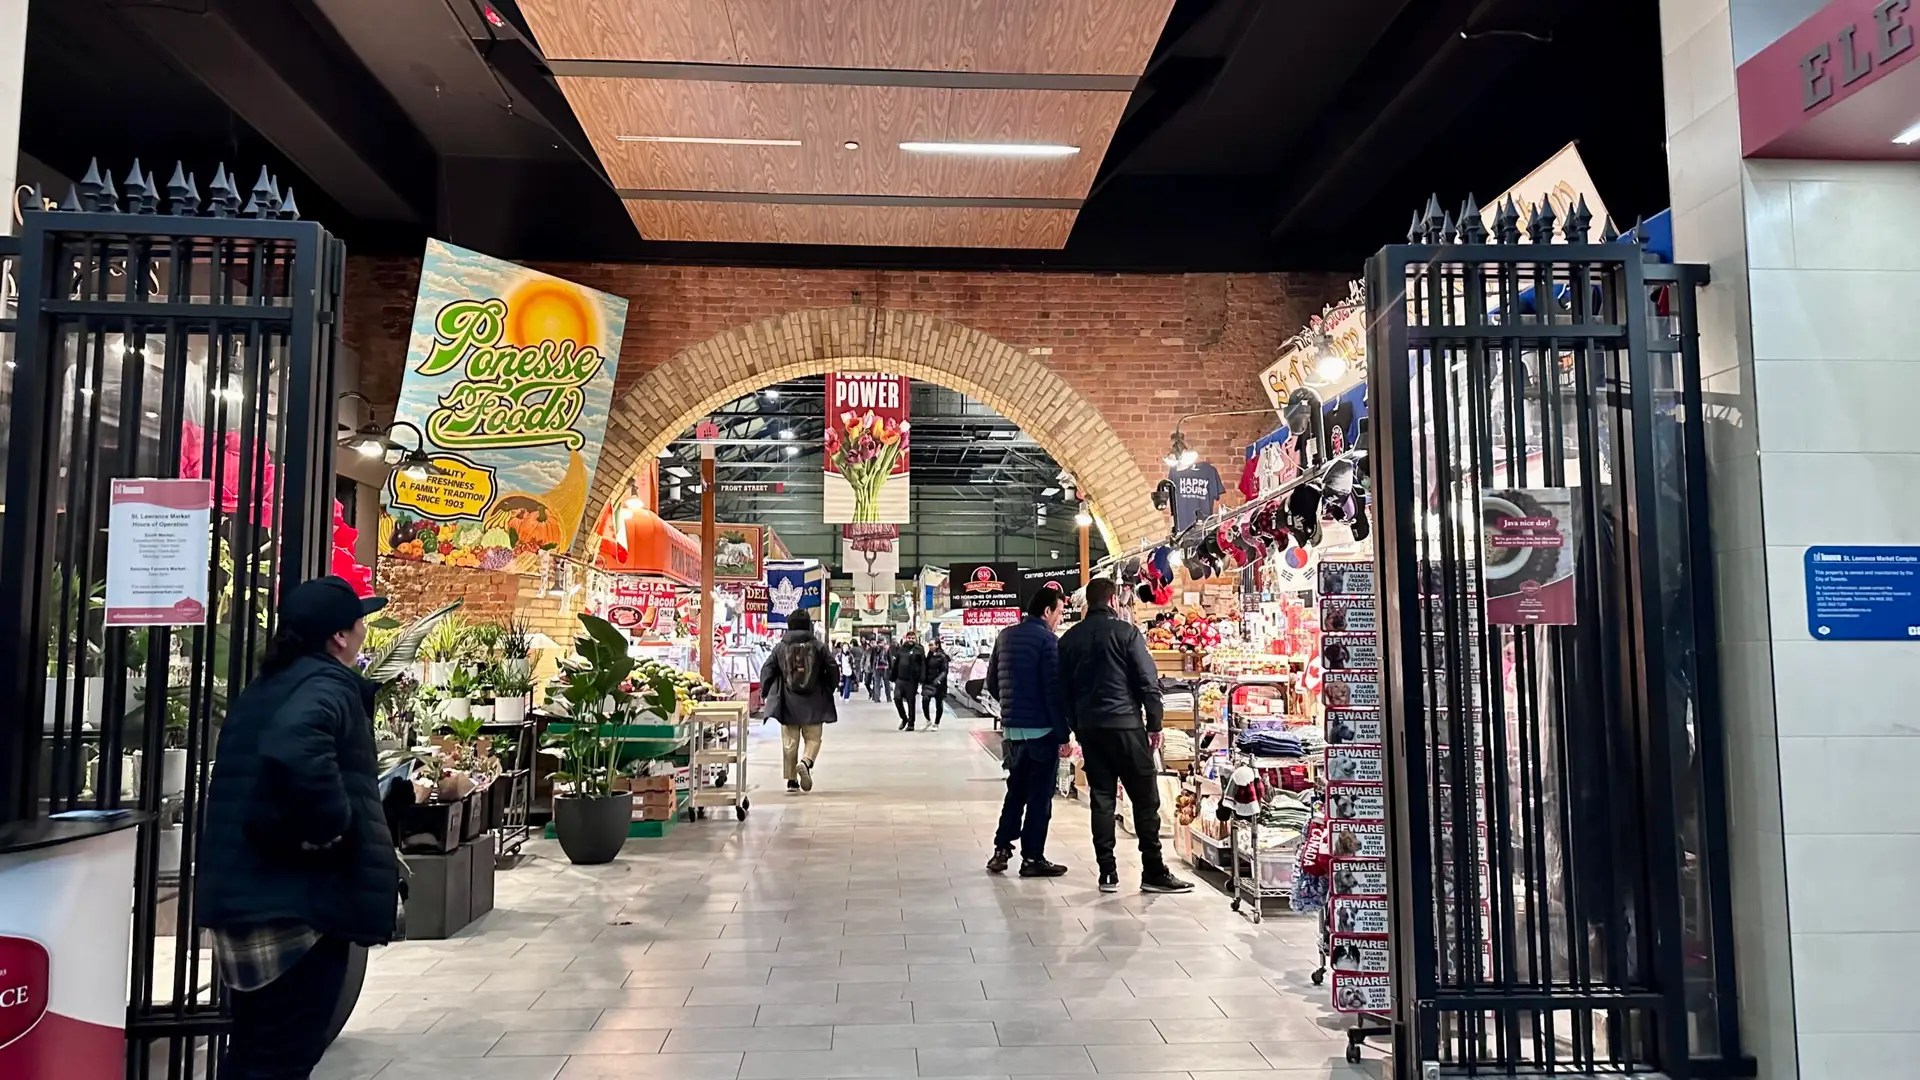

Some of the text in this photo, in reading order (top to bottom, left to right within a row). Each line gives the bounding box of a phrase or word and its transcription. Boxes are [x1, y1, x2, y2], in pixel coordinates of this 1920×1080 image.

[415, 298, 605, 380] Ponesse
[835, 380, 899, 408] POWER
[430, 378, 585, 446] Foods
[444, 468, 467, 479] ALITY
[426, 475, 475, 490] FRESHNESS
[1180, 477, 1208, 488] HAPPY
[399, 481, 486, 502] A FAMILY TRADITION
[416, 493, 465, 509] SINCE 1903
[1503, 519, 1518, 528] Java
[1535, 519, 1551, 528] day!
[610, 578, 675, 592] SPECIAL
[611, 594, 675, 607] eameal Bacon
[659, 609, 674, 617] ONLY
[1325, 637, 1376, 646] BEWARE
[1325, 673, 1377, 682] BEWARE
[1327, 711, 1379, 720] BEWARE
[1328, 749, 1382, 758] BEWARE!
[1330, 786, 1383, 796] BEWARE!
[1332, 823, 1384, 833] BEWARE
[1303, 828, 1323, 866] CANADA
[1334, 899, 1388, 909] BEWARE!
[1334, 937, 1388, 949] BEWARE!
[1336, 976, 1390, 986] BEWARE!
